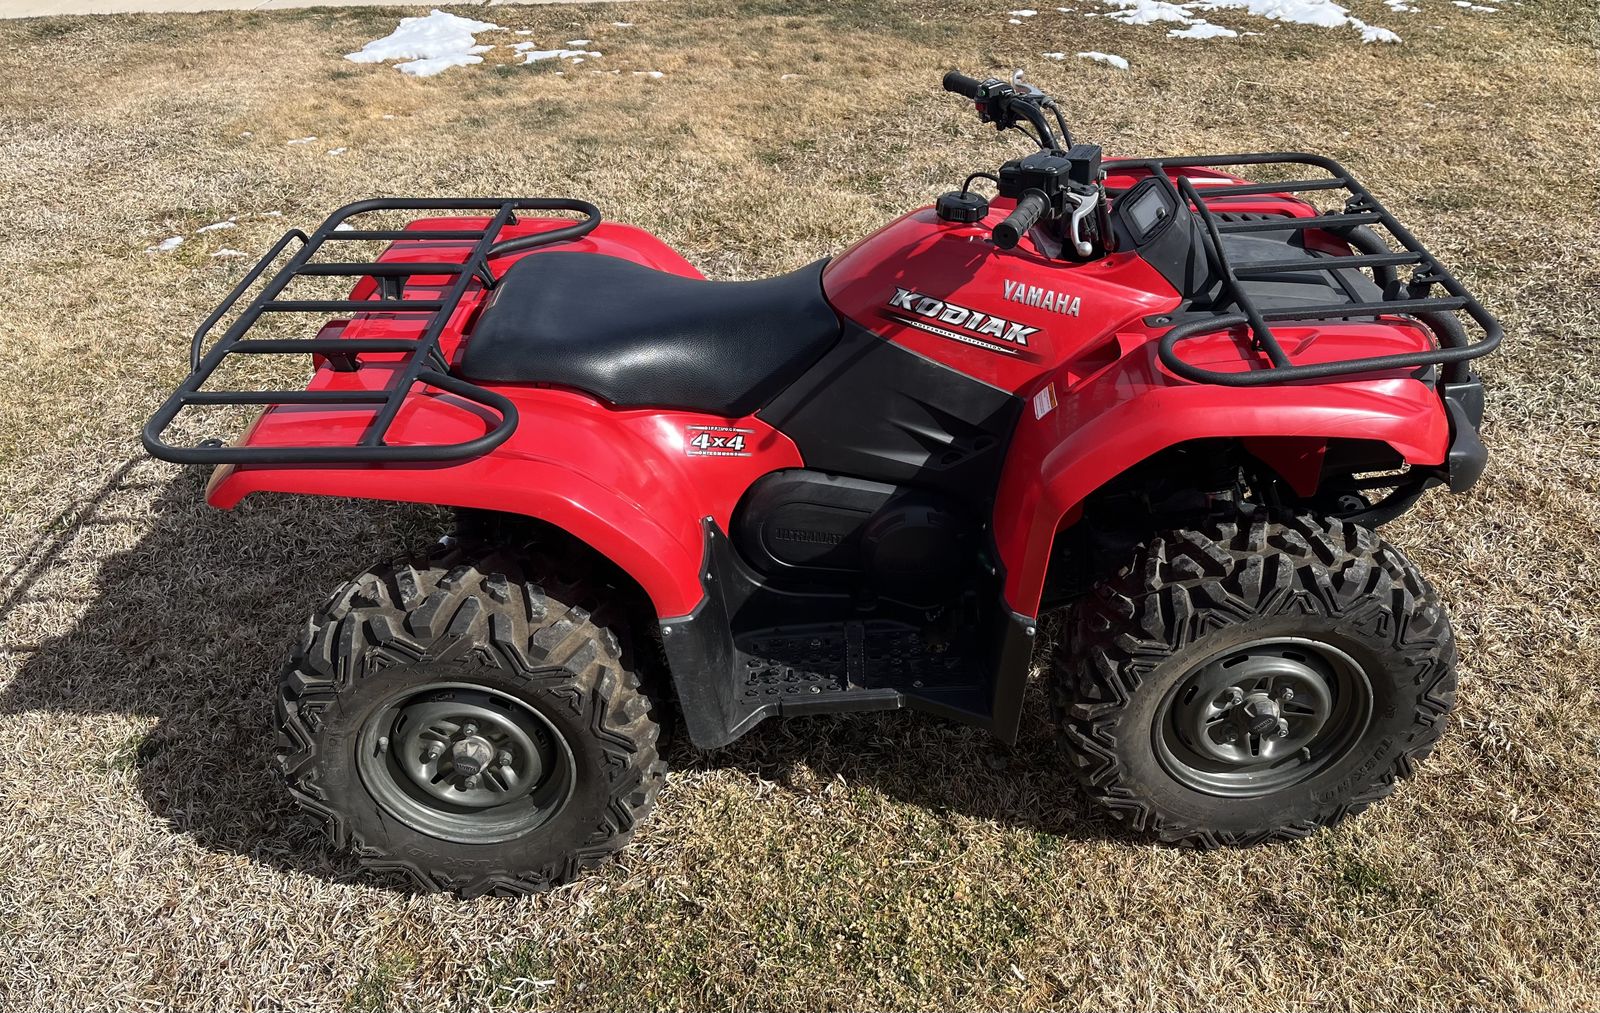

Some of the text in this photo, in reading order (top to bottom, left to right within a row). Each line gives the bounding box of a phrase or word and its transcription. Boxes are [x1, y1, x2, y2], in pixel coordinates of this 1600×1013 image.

[888, 287, 1042, 346] KODIAK
[1003, 279, 1081, 317] YAMAHA
[690, 432, 746, 452] 4x4
